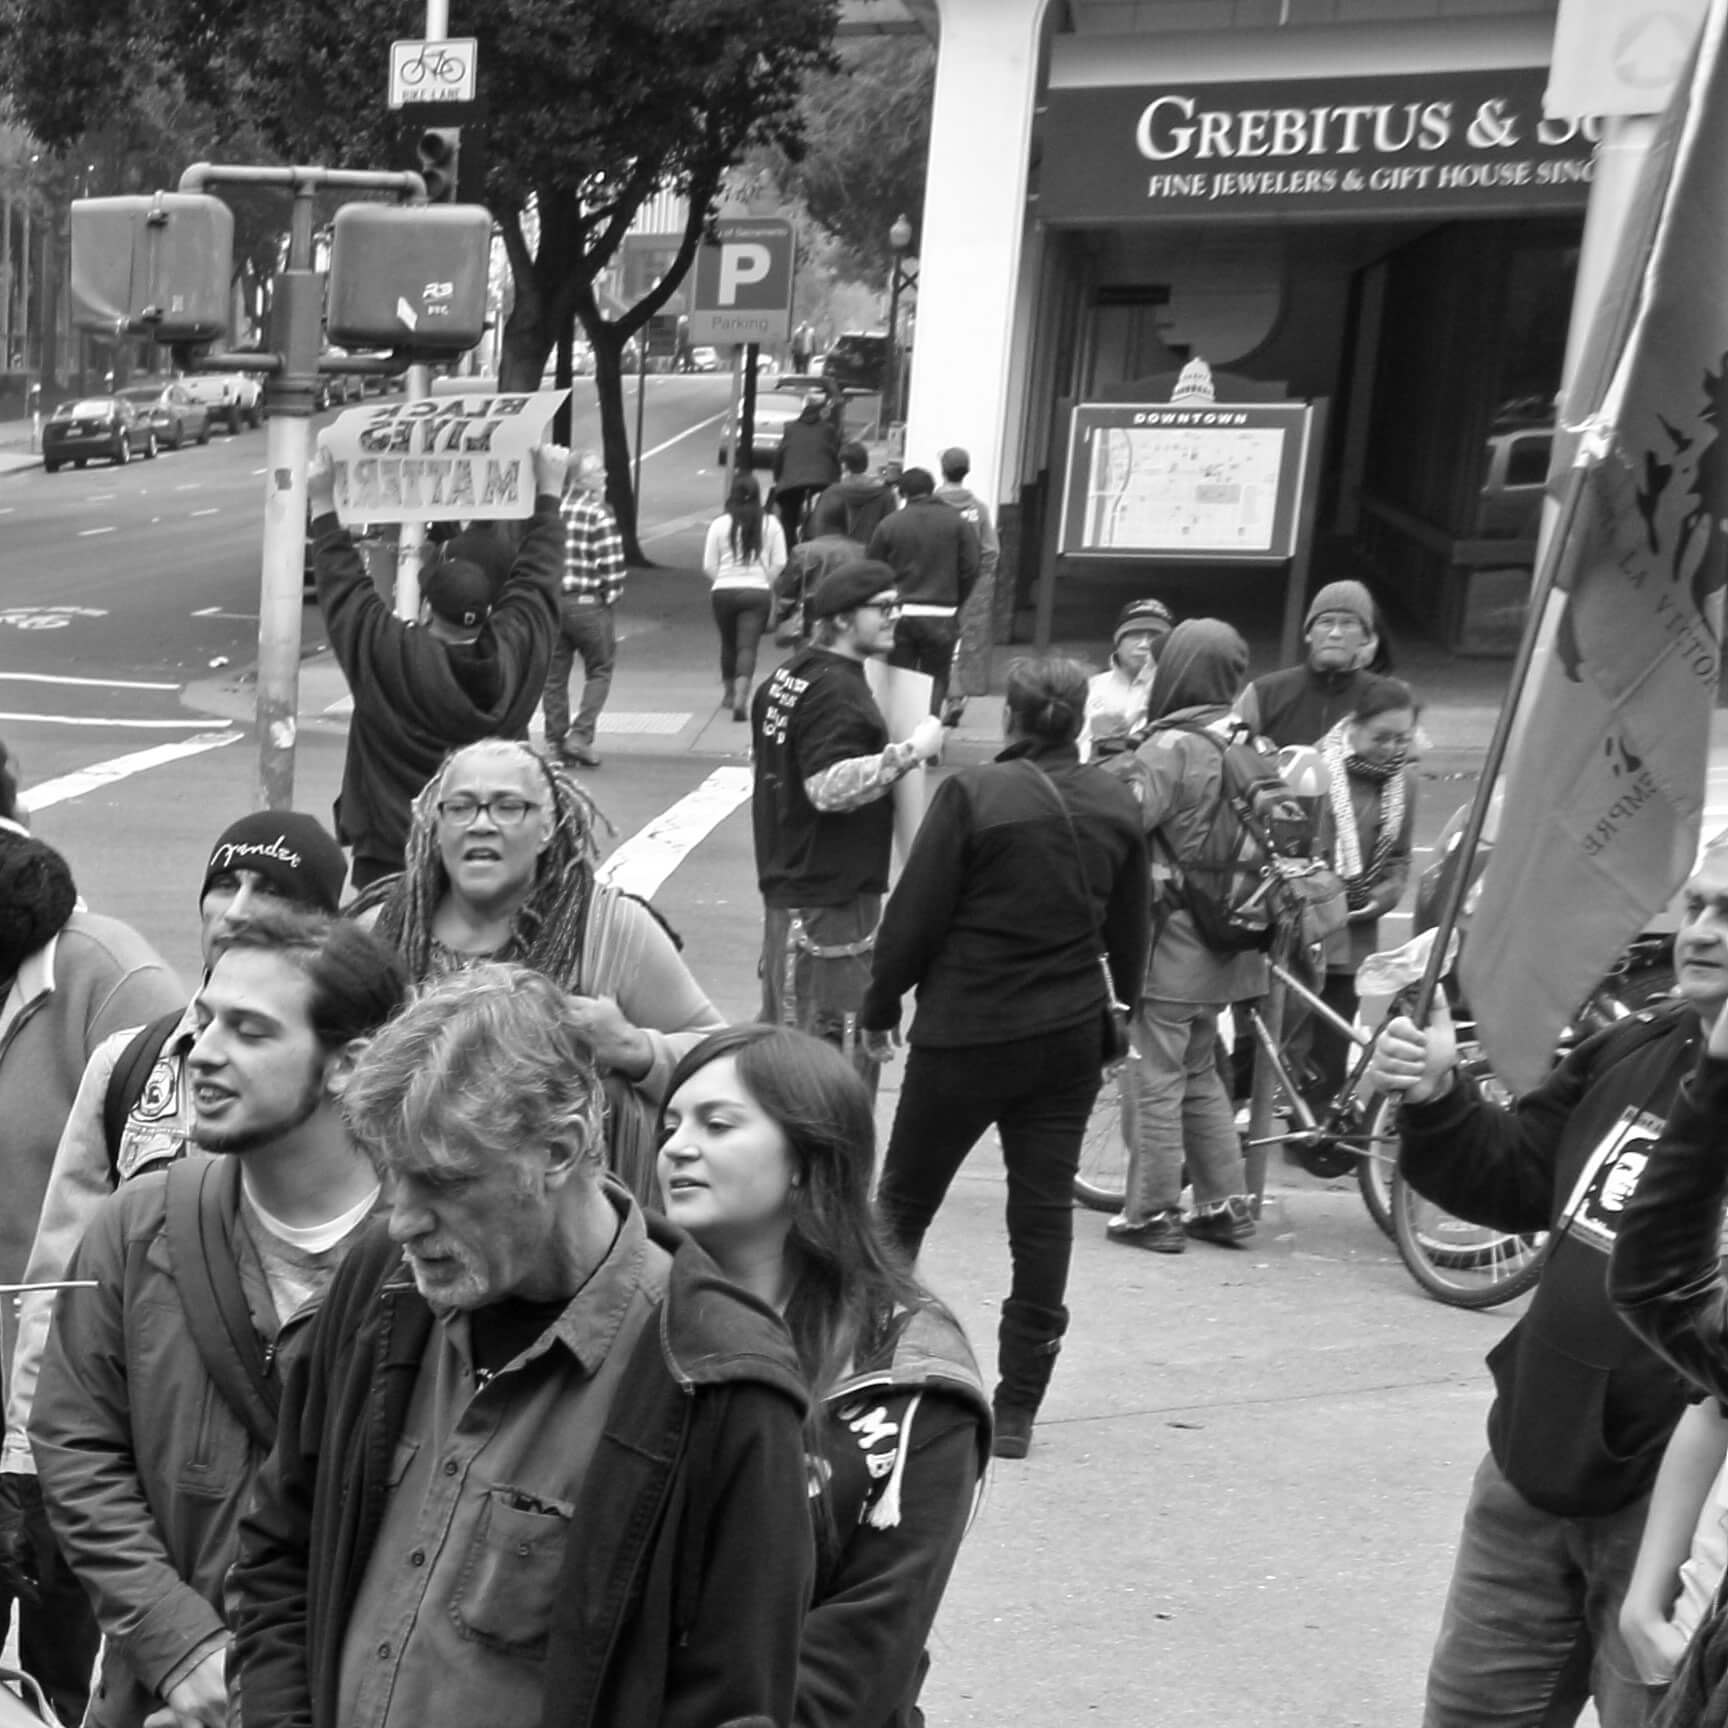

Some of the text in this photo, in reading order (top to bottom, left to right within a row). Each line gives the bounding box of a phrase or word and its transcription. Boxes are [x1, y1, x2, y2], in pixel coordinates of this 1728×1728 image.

[401, 86, 461, 101] BIKE LANE
[1135, 94, 1452, 161] GREBITUS
[1466, 99, 1521, 150] &
[1148, 173, 1208, 198] FINE
[1208, 168, 1337, 201] JEWELERS
[1368, 164, 1437, 191] GIFT
[1438, 162, 1530, 189] HOUSE
[717, 242, 772, 306] P
[1133, 412, 1249, 426] DOWNTOWN
